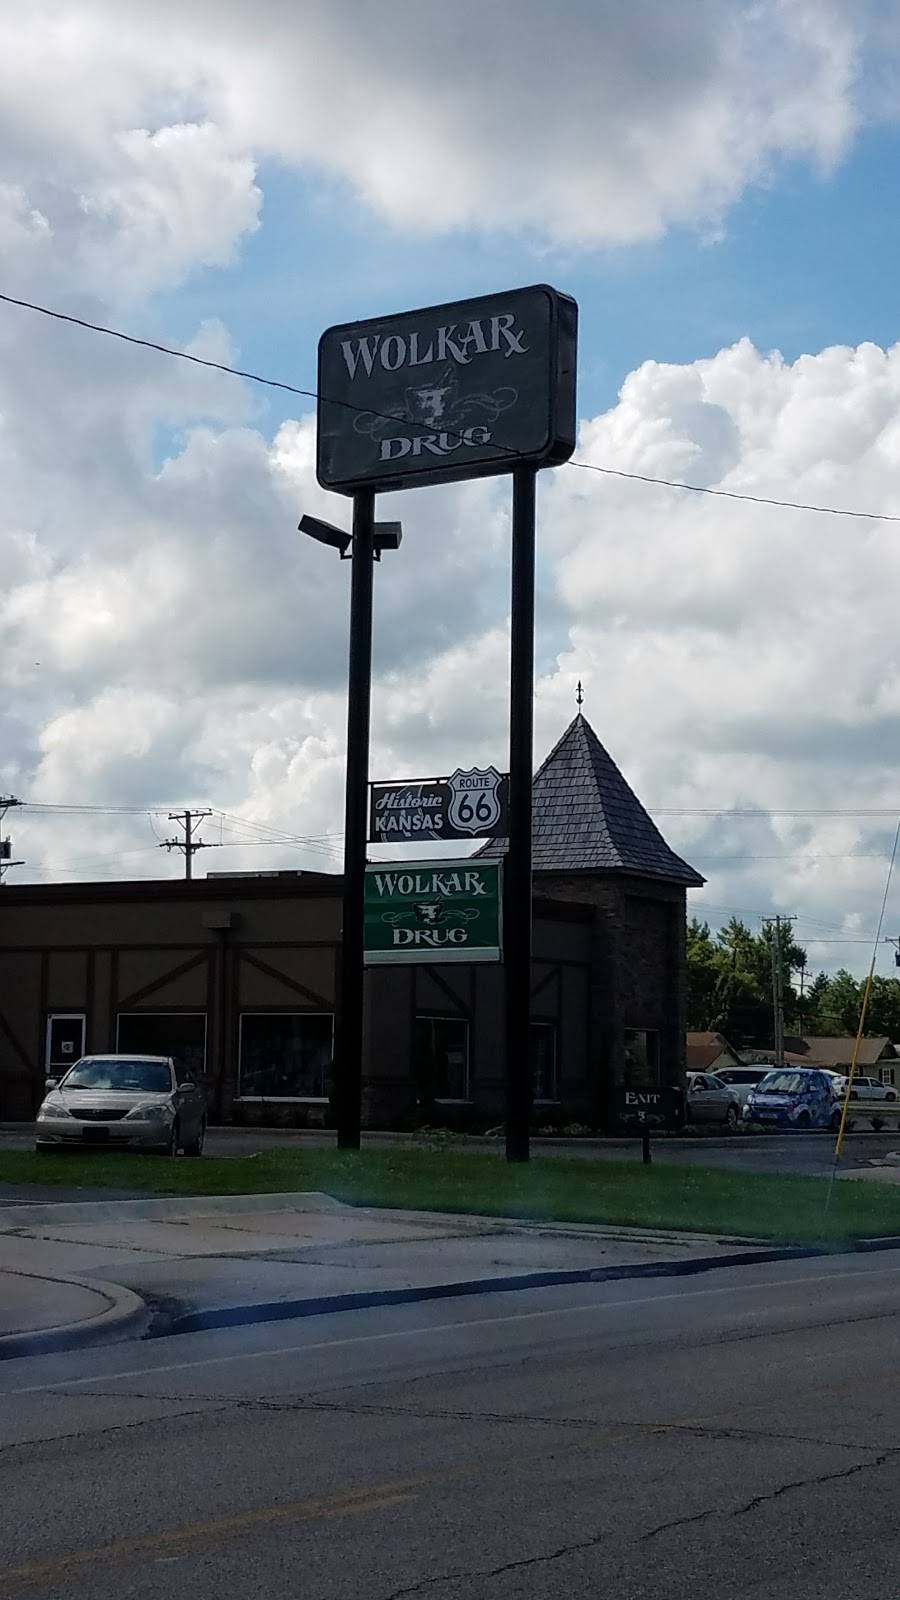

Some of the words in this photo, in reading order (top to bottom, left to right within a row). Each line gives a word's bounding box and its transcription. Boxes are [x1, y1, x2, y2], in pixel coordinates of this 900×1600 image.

[379, 426, 492, 461] DRUG
[459, 778, 490, 788] ROUTE
[375, 792, 442, 810] Historic
[458, 792, 491, 822] 66
[375, 813, 443, 832] KANSAS
[393, 927, 468, 946] DRUG
[625, 1091, 660, 1105] EXIT
